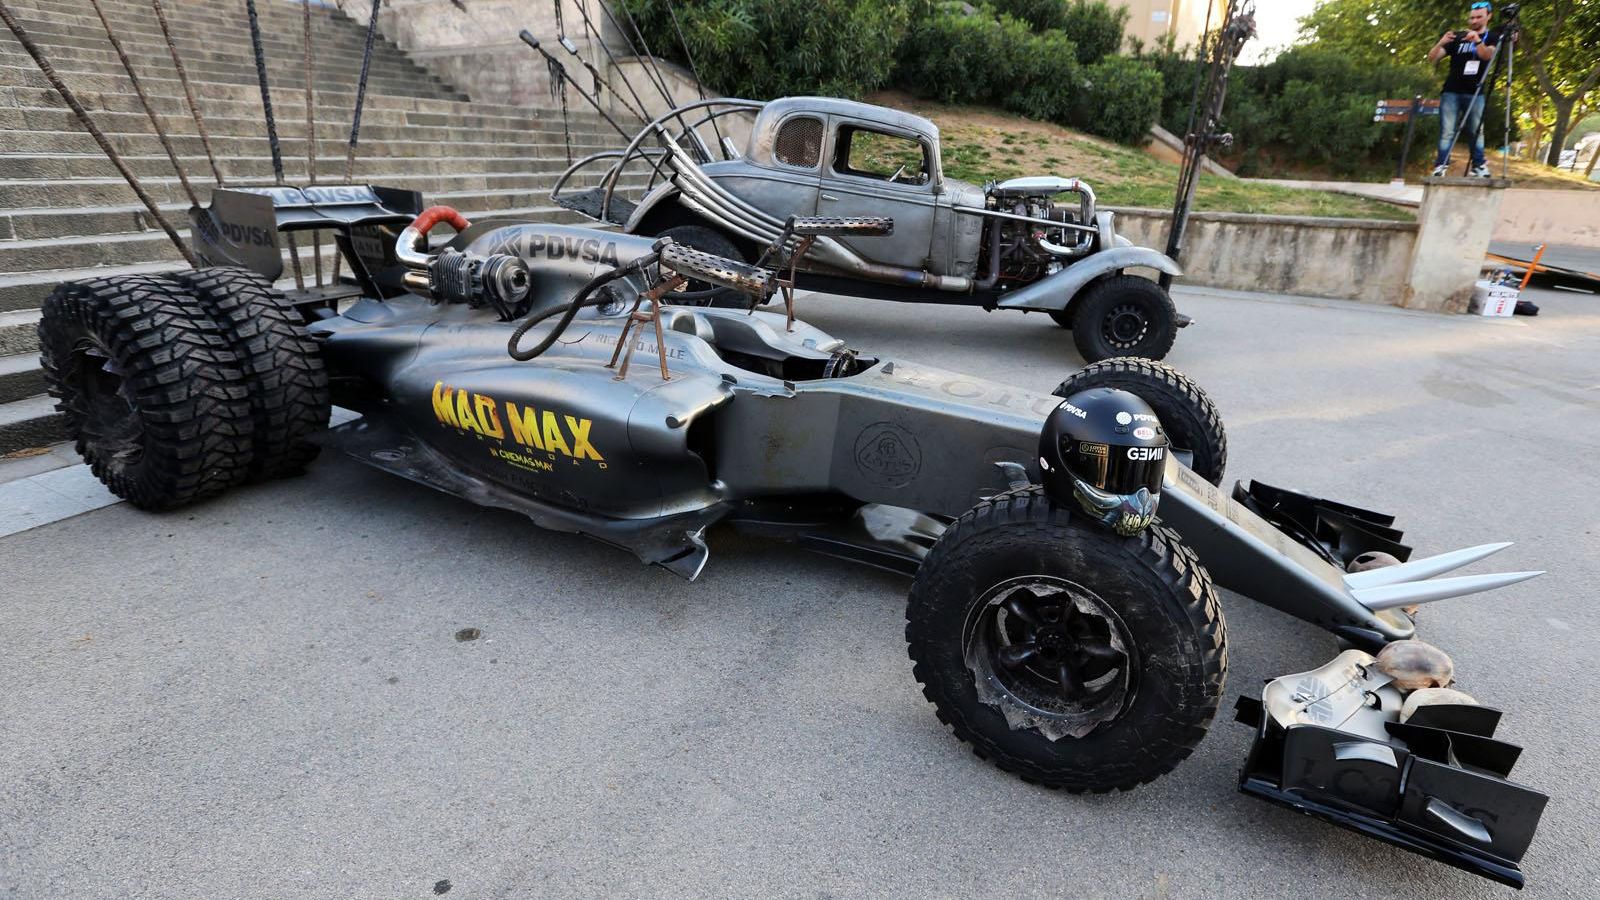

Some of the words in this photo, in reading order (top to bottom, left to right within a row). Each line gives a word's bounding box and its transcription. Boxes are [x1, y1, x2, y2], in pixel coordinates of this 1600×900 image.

[220, 223, 275, 249] PDVSA
[529, 234, 620, 268] PDVSA
[431, 380, 506, 440] MAD
[505, 401, 605, 461] MAX
[1064, 403, 1088, 420] PDVSA
